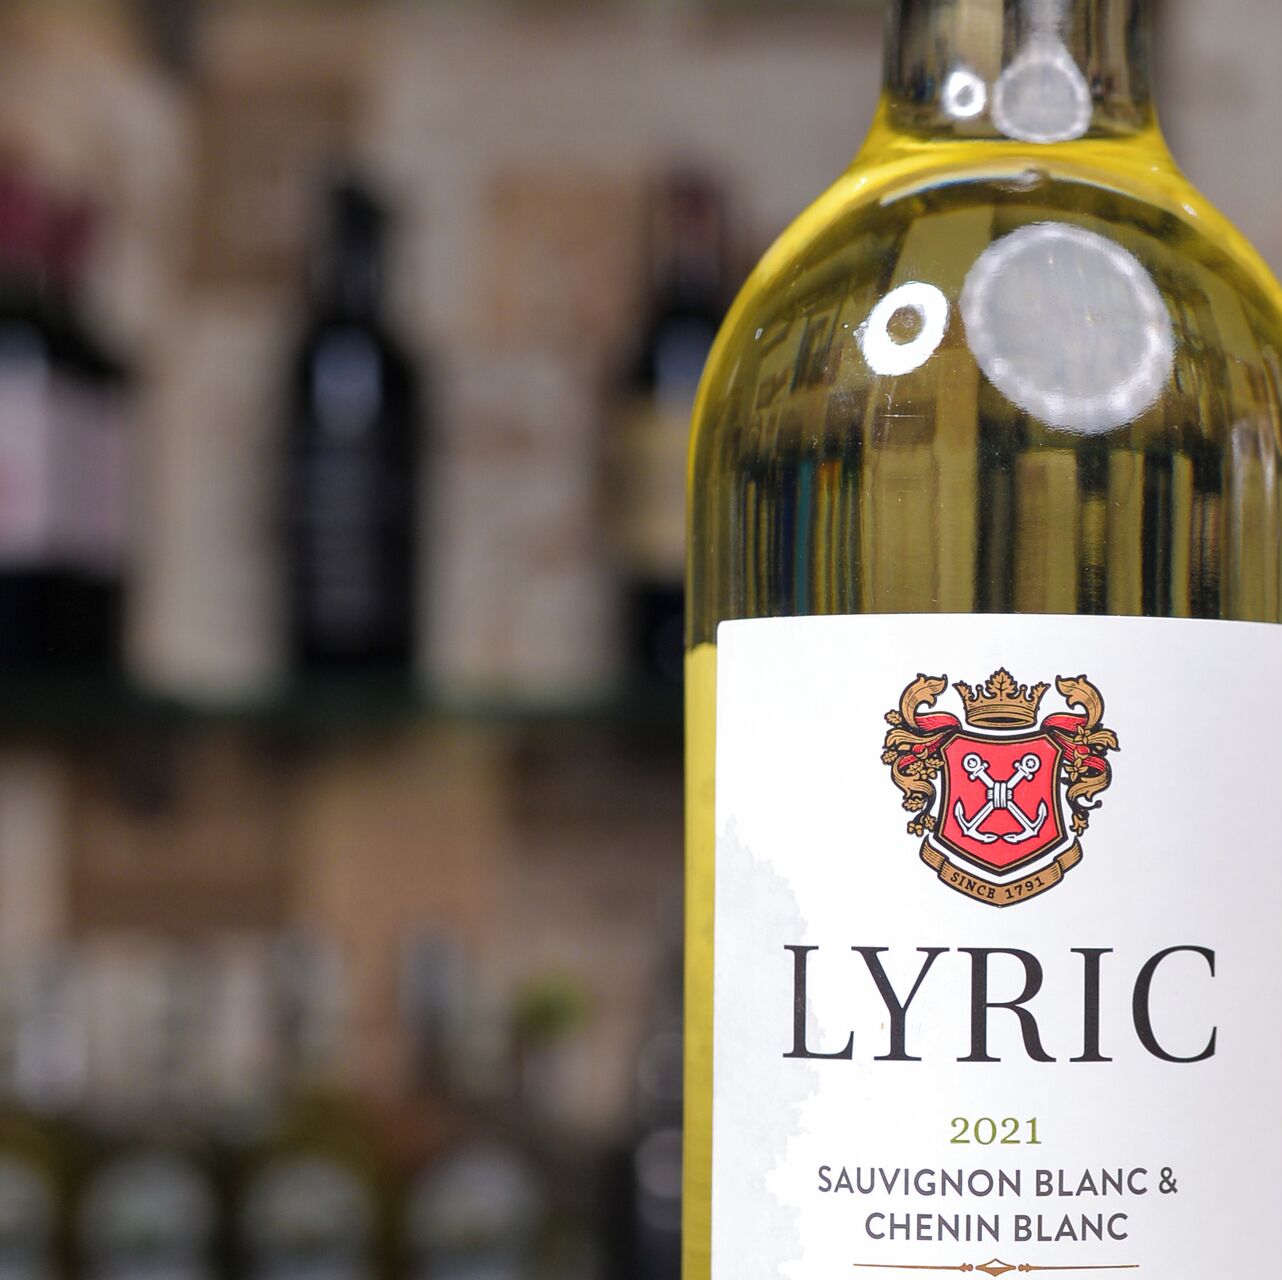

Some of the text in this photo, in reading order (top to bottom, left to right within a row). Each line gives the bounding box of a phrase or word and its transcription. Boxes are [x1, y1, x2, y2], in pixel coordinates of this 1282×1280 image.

[950, 871, 1046, 899] SINCE 1791
[783, 945, 1218, 1063] LYRIC
[949, 1116, 1043, 1145] 2021
[817, 1165, 1179, 1197] SAUVIGNON BLANC &
[864, 1211, 1129, 1242] CHENIN BLANC
